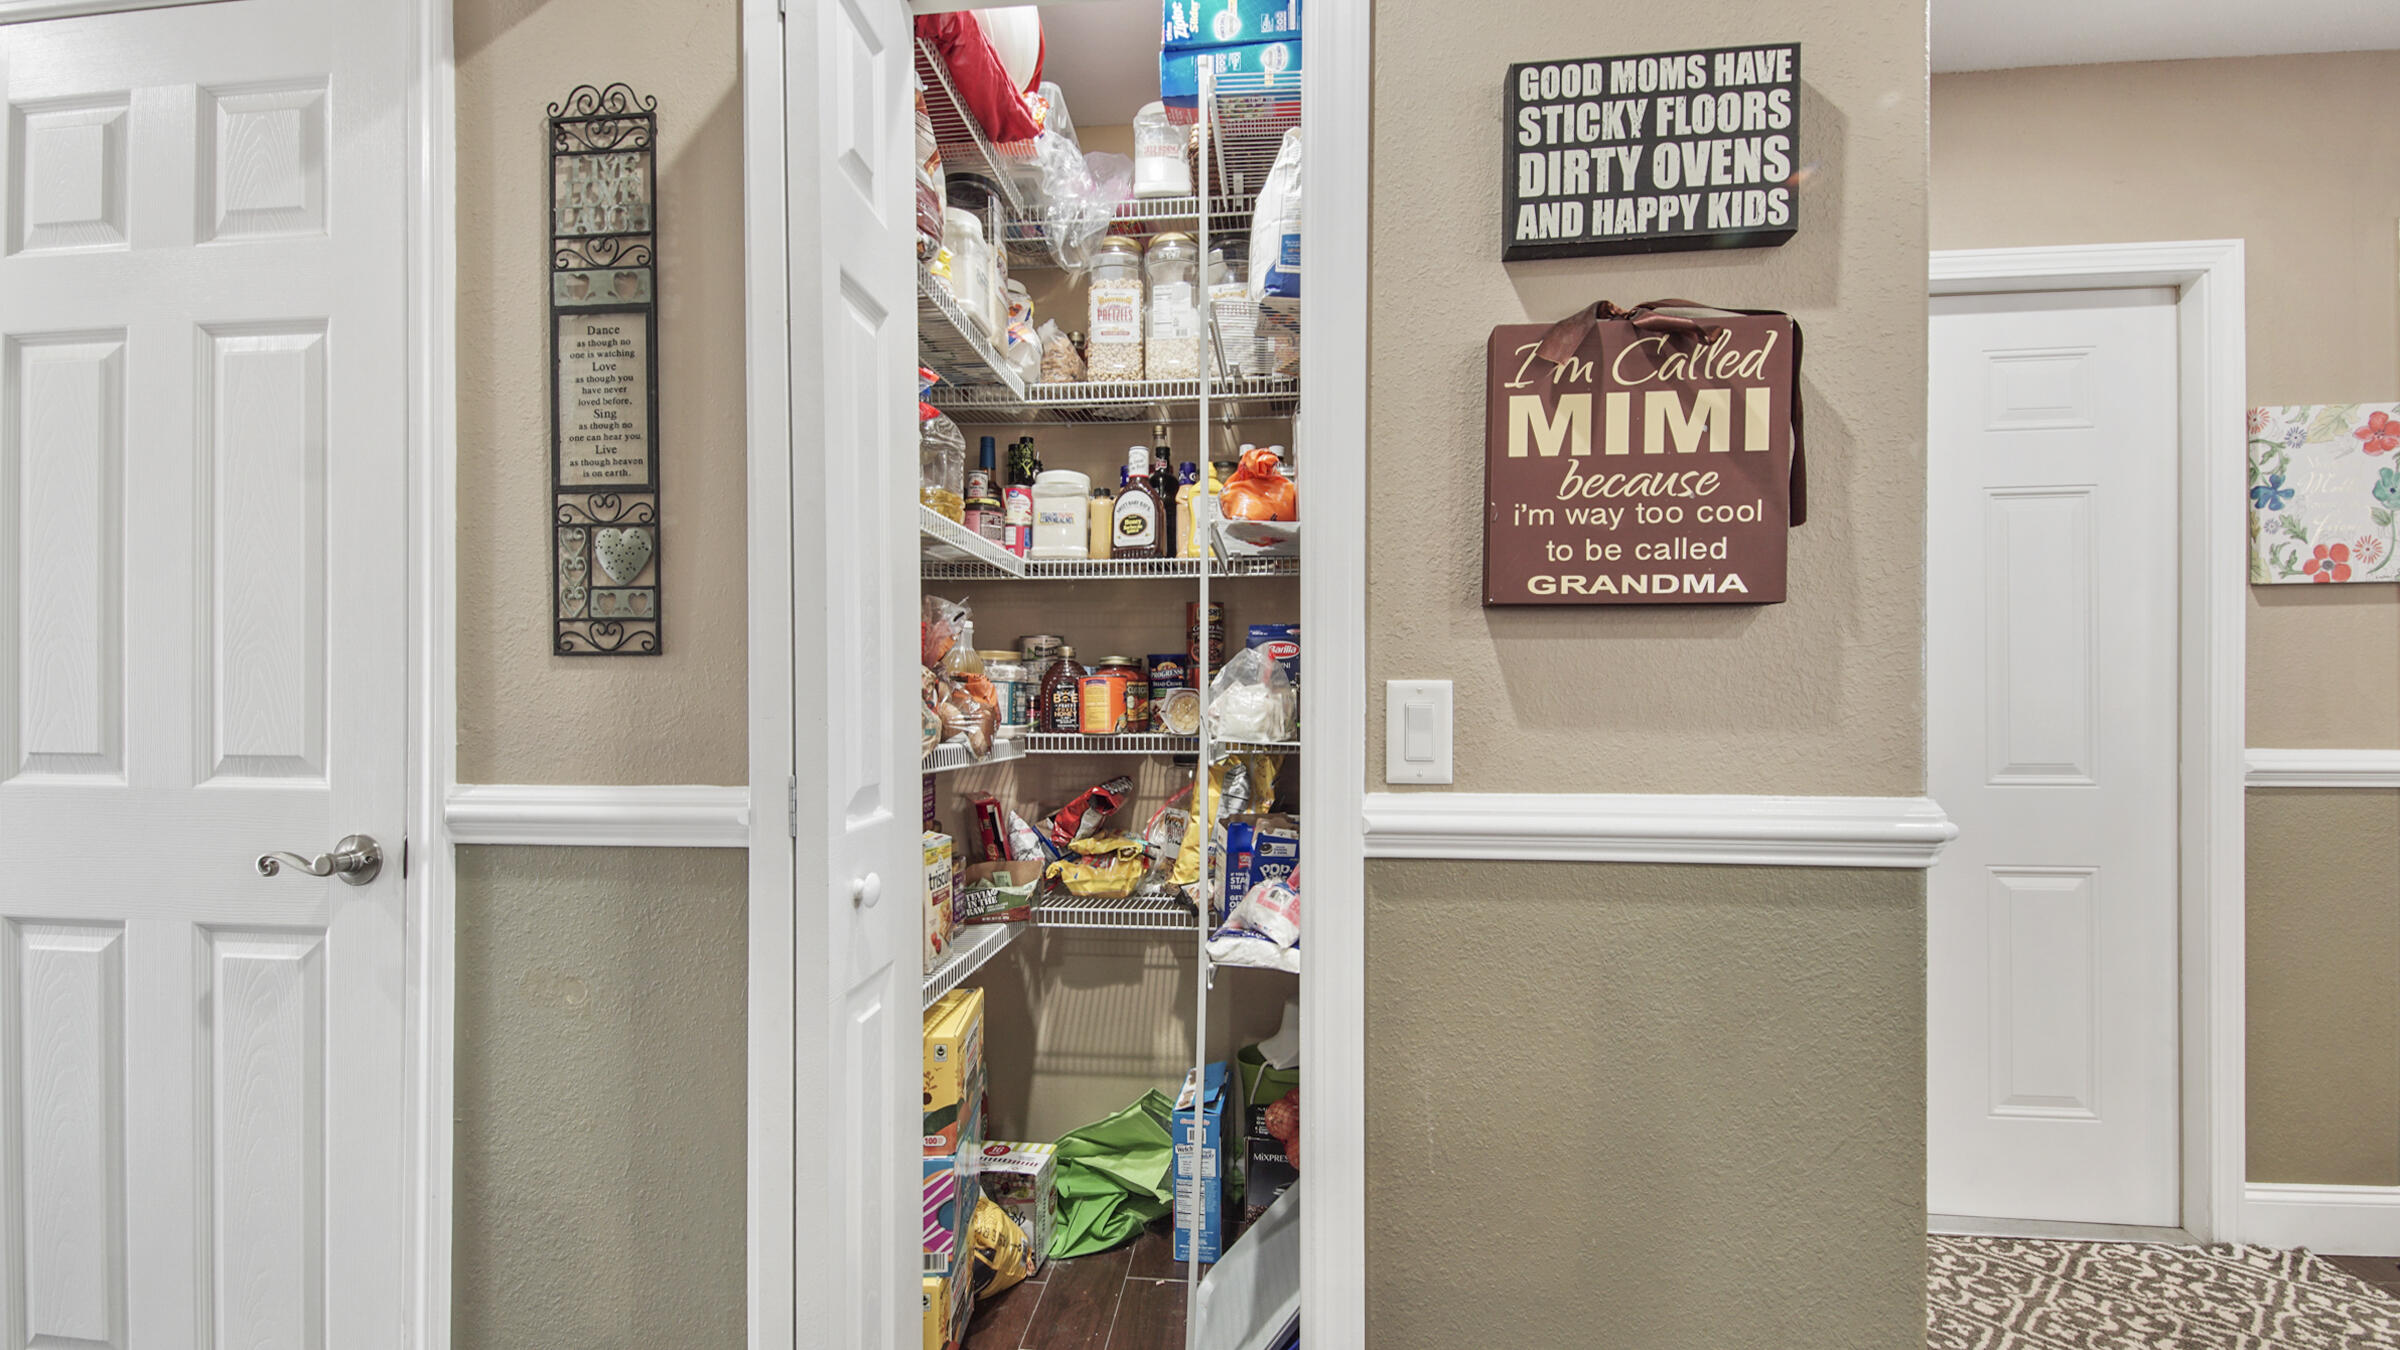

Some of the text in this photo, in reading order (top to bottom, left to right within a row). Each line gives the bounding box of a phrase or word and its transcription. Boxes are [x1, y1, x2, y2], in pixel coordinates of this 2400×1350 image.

[1519, 48, 1792, 102] GOOD MOMS HAVE
[1518, 88, 1792, 147] STICKY FLOORS
[1518, 135, 1791, 198] DIRTY OVENS
[564, 175, 641, 208] LOVE
[1515, 187, 1790, 241] AND HAPPY KIDS
[587, 325, 620, 336] Dance
[577, 340, 586, 348] as
[588, 338, 618, 348] though
[587, 350, 595, 359] is
[597, 349, 635, 359] watching
[1611, 328, 1779, 387] Called
[592, 362, 616, 372] Love
[587, 374, 615, 384] though
[618, 375, 634, 383] you
[582, 386, 601, 394] have
[578, 398, 600, 406] loved
[593, 409, 617, 420] Sing
[590, 421, 620, 431] though
[1507, 387, 1771, 458] MIMI
[569, 434, 584, 442] one
[603, 432, 622, 441] hear
[595, 444, 617, 454] Live
[570, 457, 643, 468] as though heaven
[583, 470, 590, 478] is
[1556, 459, 1721, 501] because
[1513, 499, 1763, 531] i'm way too cool
[1546, 536, 1727, 562] to be called
[1527, 573, 1749, 595] GRANDMA
